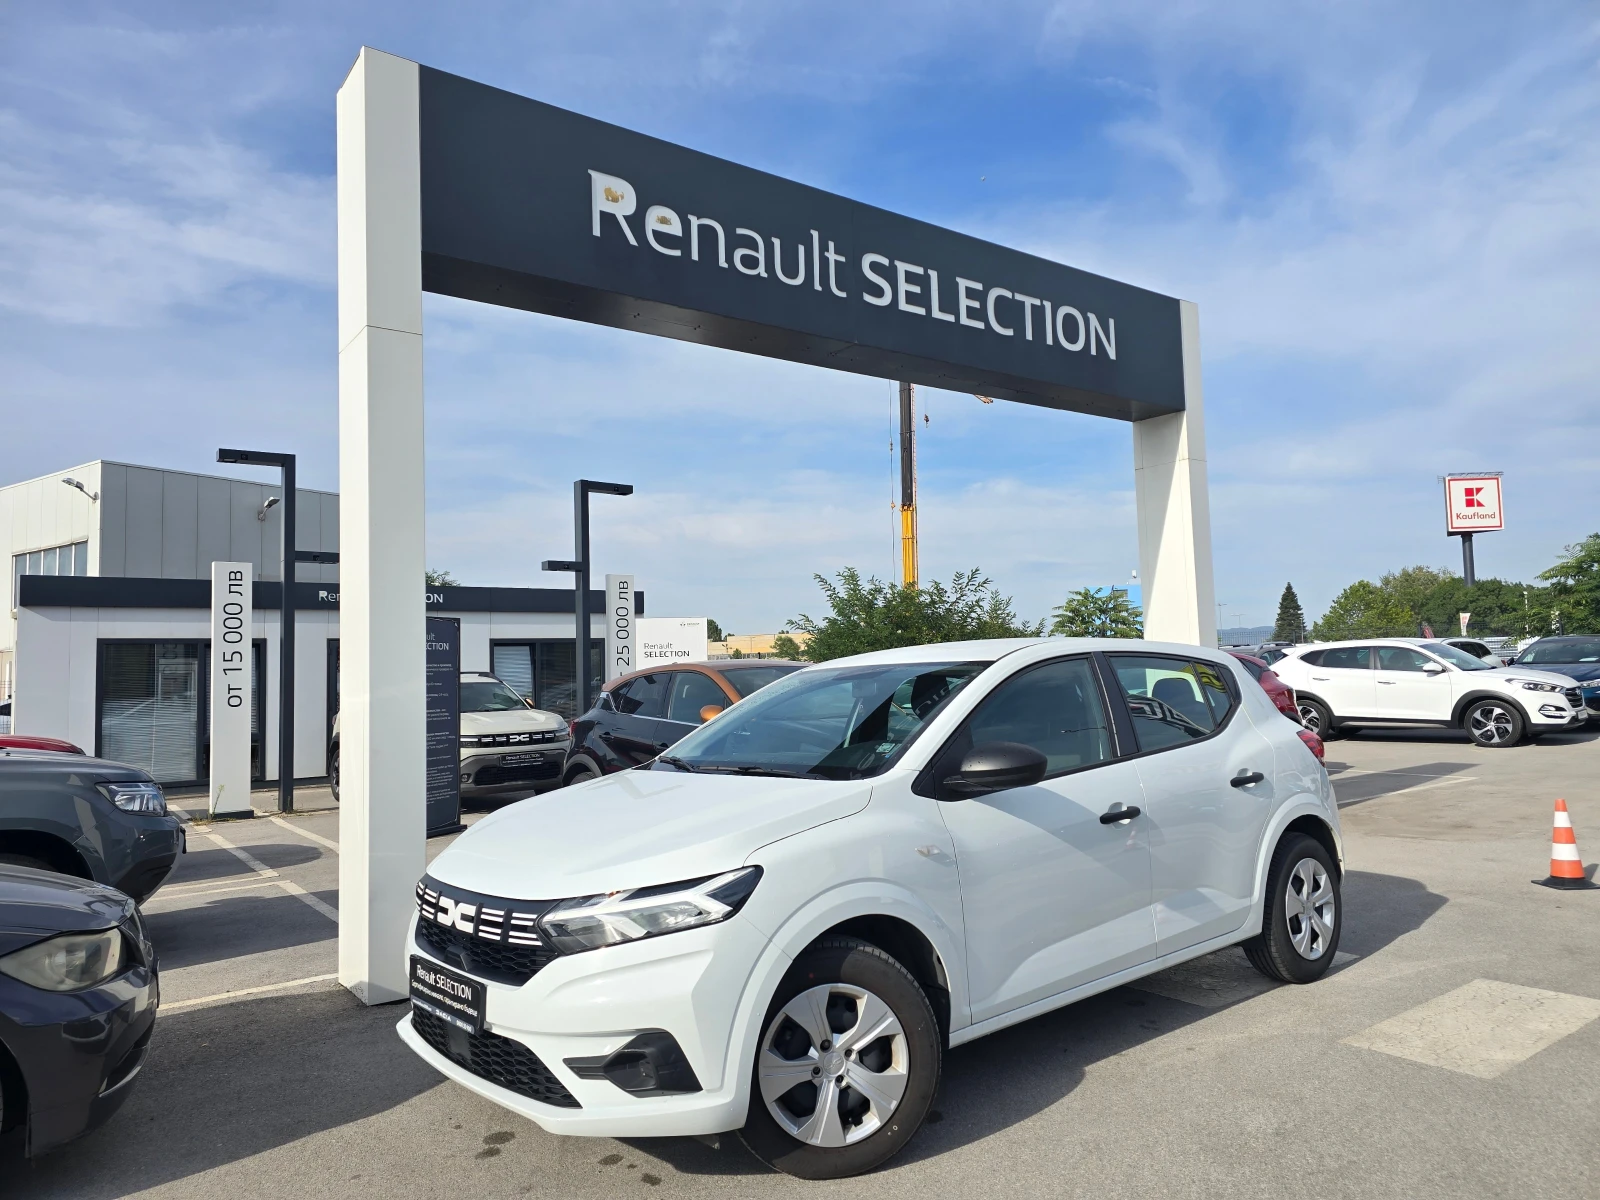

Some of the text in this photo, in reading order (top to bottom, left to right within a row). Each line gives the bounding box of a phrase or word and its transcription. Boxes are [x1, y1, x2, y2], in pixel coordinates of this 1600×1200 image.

[587, 169, 1118, 361] Renault SELECTION
[1456, 512, 1496, 520] Kaufland
[223, 602, 243, 643] 000
[616, 606, 630, 640] 000
[616, 645, 630, 667] 25
[643, 642, 673, 650] Renault
[644, 650, 690, 658] SELECTION
[222, 651, 243, 675] 15
[416, 964, 472, 1001] Renault SELECTION
